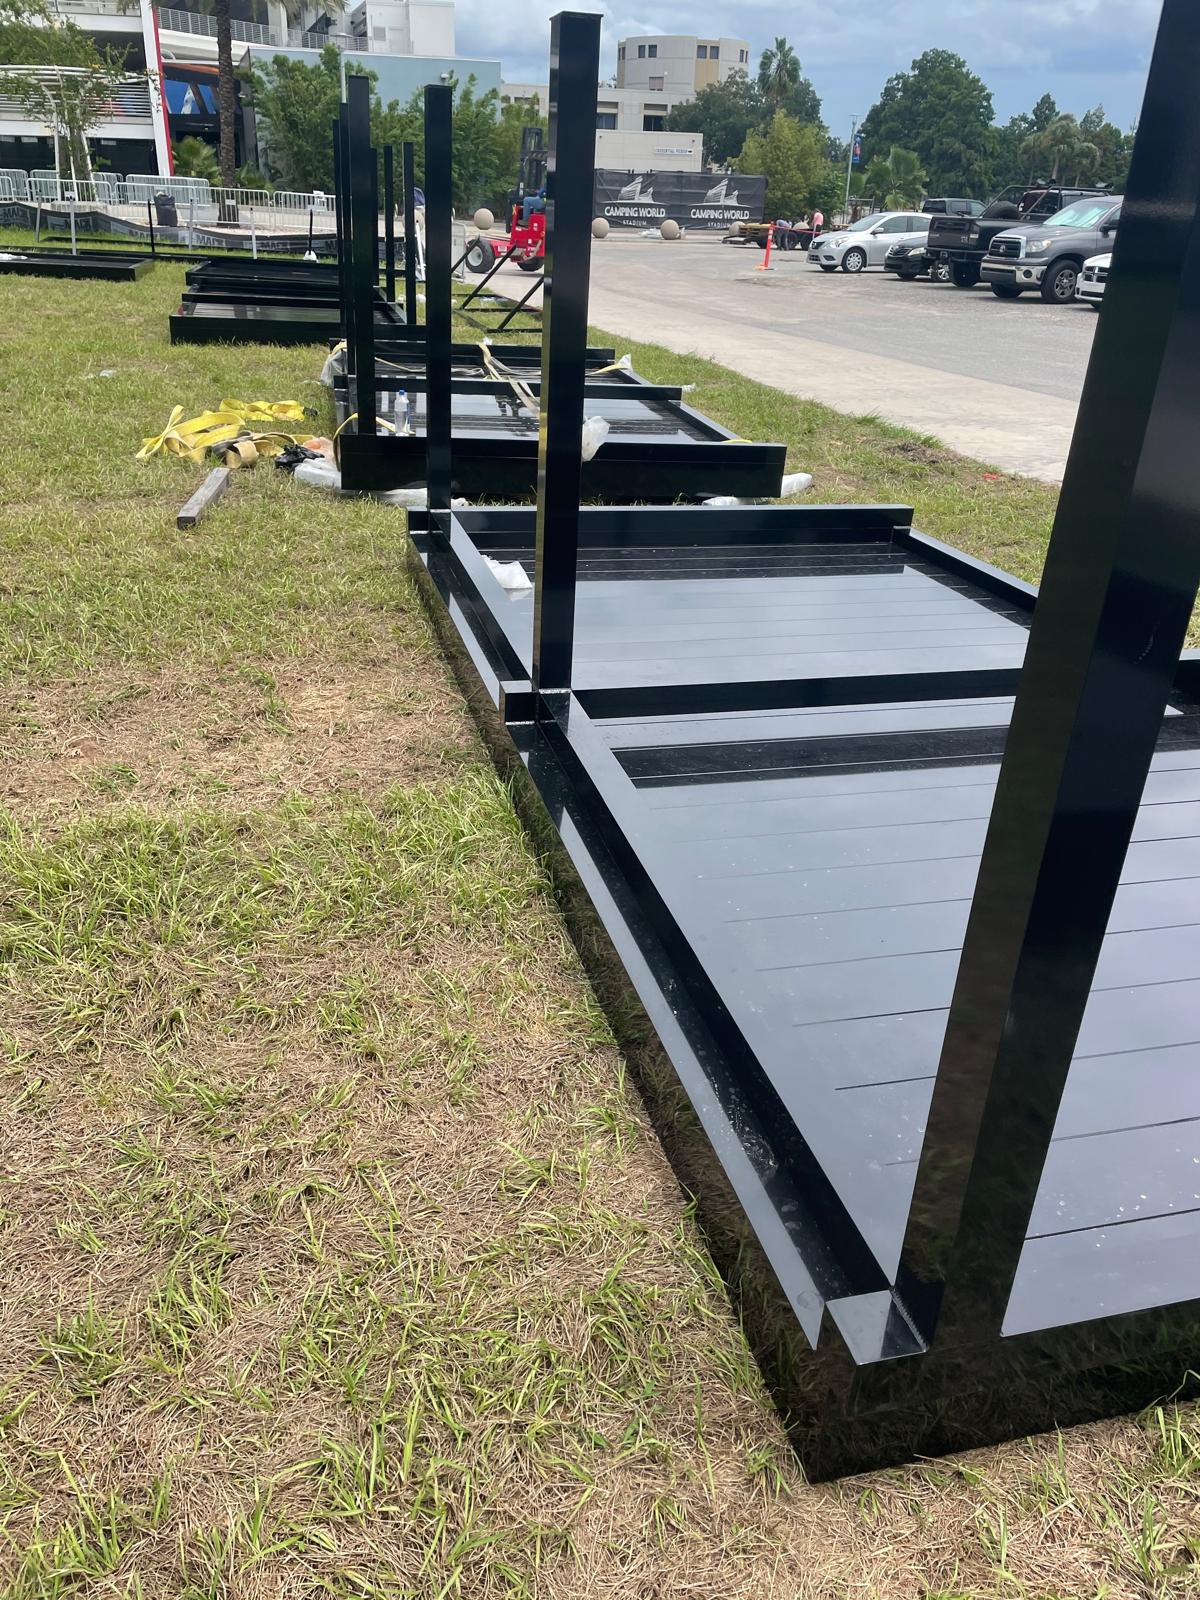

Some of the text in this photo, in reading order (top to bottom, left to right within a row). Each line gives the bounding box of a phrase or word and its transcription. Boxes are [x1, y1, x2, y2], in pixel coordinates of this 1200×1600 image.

[604, 206, 666, 218] CAMPING WORLD
[690, 208, 751, 220] CAMPING WORLD
[622, 219, 647, 227] STADIUM
